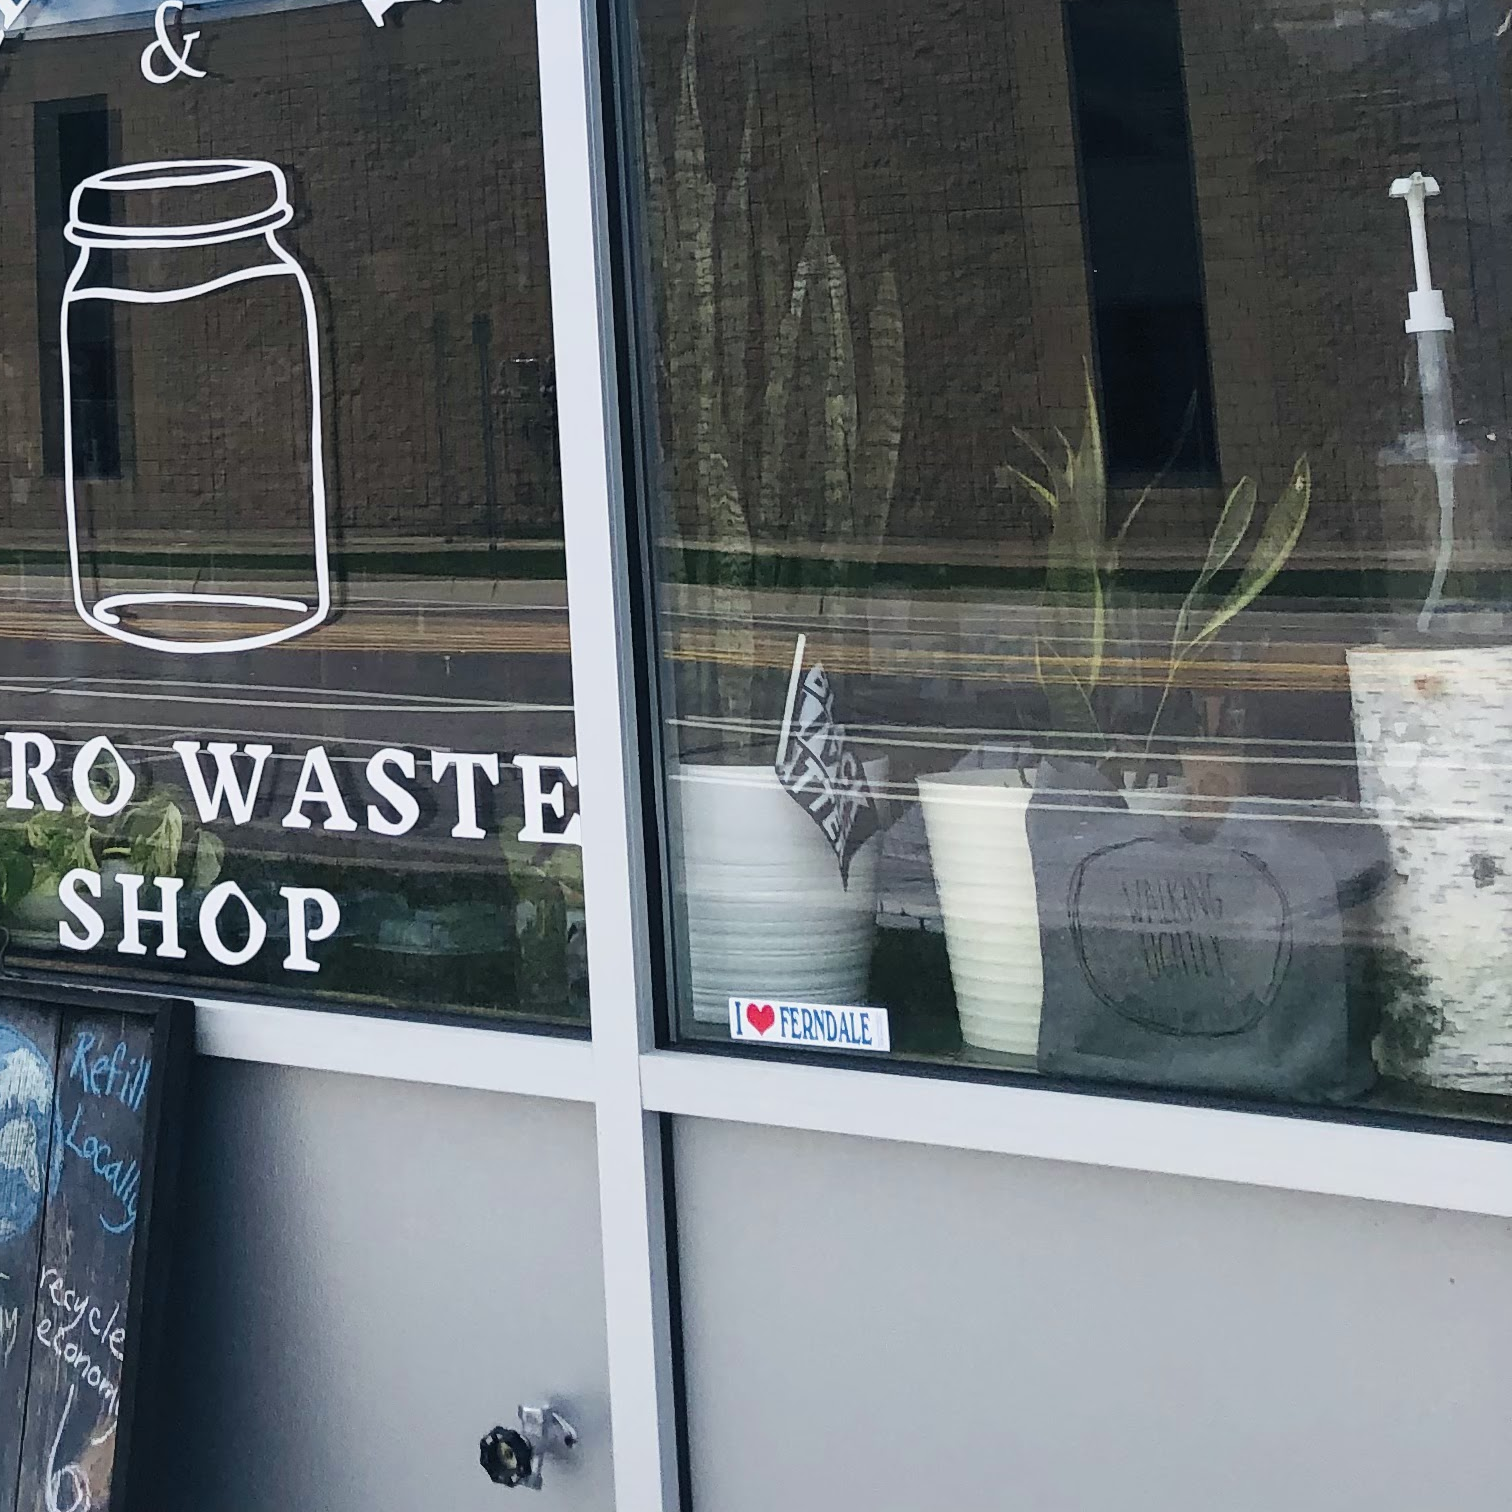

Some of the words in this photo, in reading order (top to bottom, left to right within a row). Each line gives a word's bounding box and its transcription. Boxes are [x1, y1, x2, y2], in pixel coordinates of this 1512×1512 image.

[140, 0, 207, 84] &
[173, 739, 583, 846] WASTE
[59, 867, 341, 973] SHOP
[69, 1031, 152, 1112] Refill
[734, 1001, 743, 1036] I
[779, 1005, 873, 1046] FERNDALE
[65, 1102, 141, 1235] Locally
[40, 1264, 126, 1362] recycle
